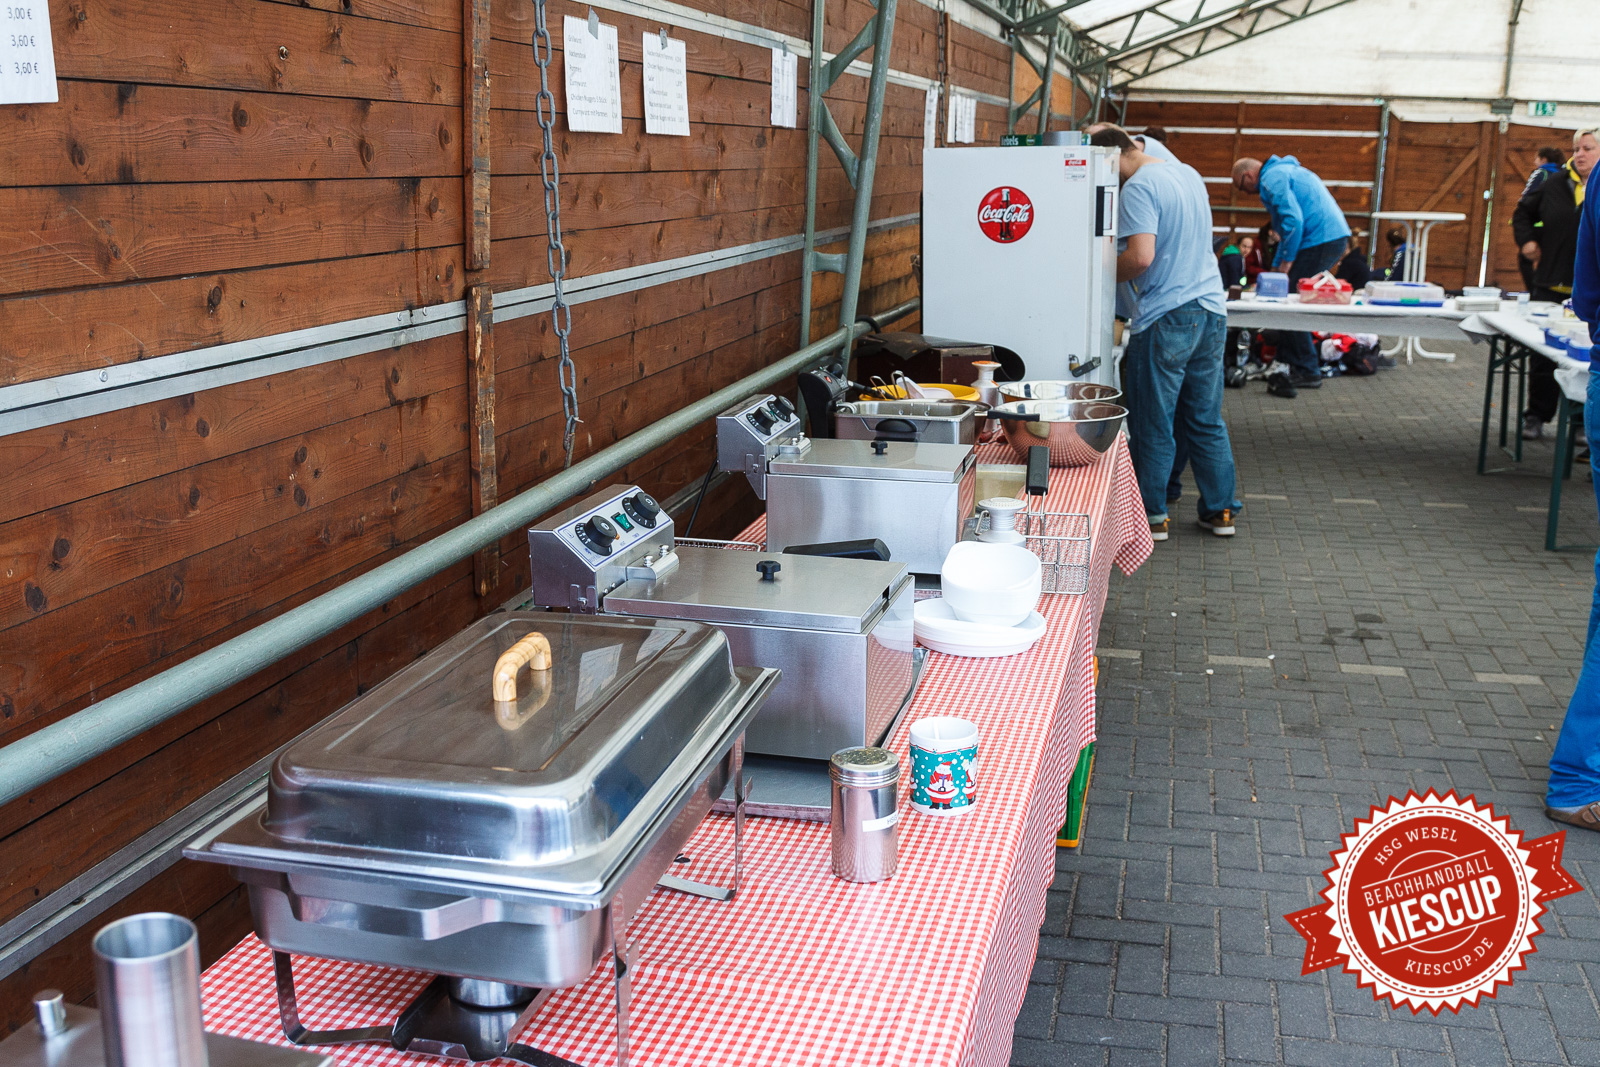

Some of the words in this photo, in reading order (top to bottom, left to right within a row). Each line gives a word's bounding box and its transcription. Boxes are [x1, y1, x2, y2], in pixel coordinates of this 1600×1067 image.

[7, 6, 25, 20] 3,00
[27, 8, 32, 20] €
[11, 34, 28, 48] 3,60
[30, 35, 36, 47] €
[14, 61, 32, 76] 3,60
[33, 62, 39, 74] €
[979, 203, 1031, 223] Coca-Cola
